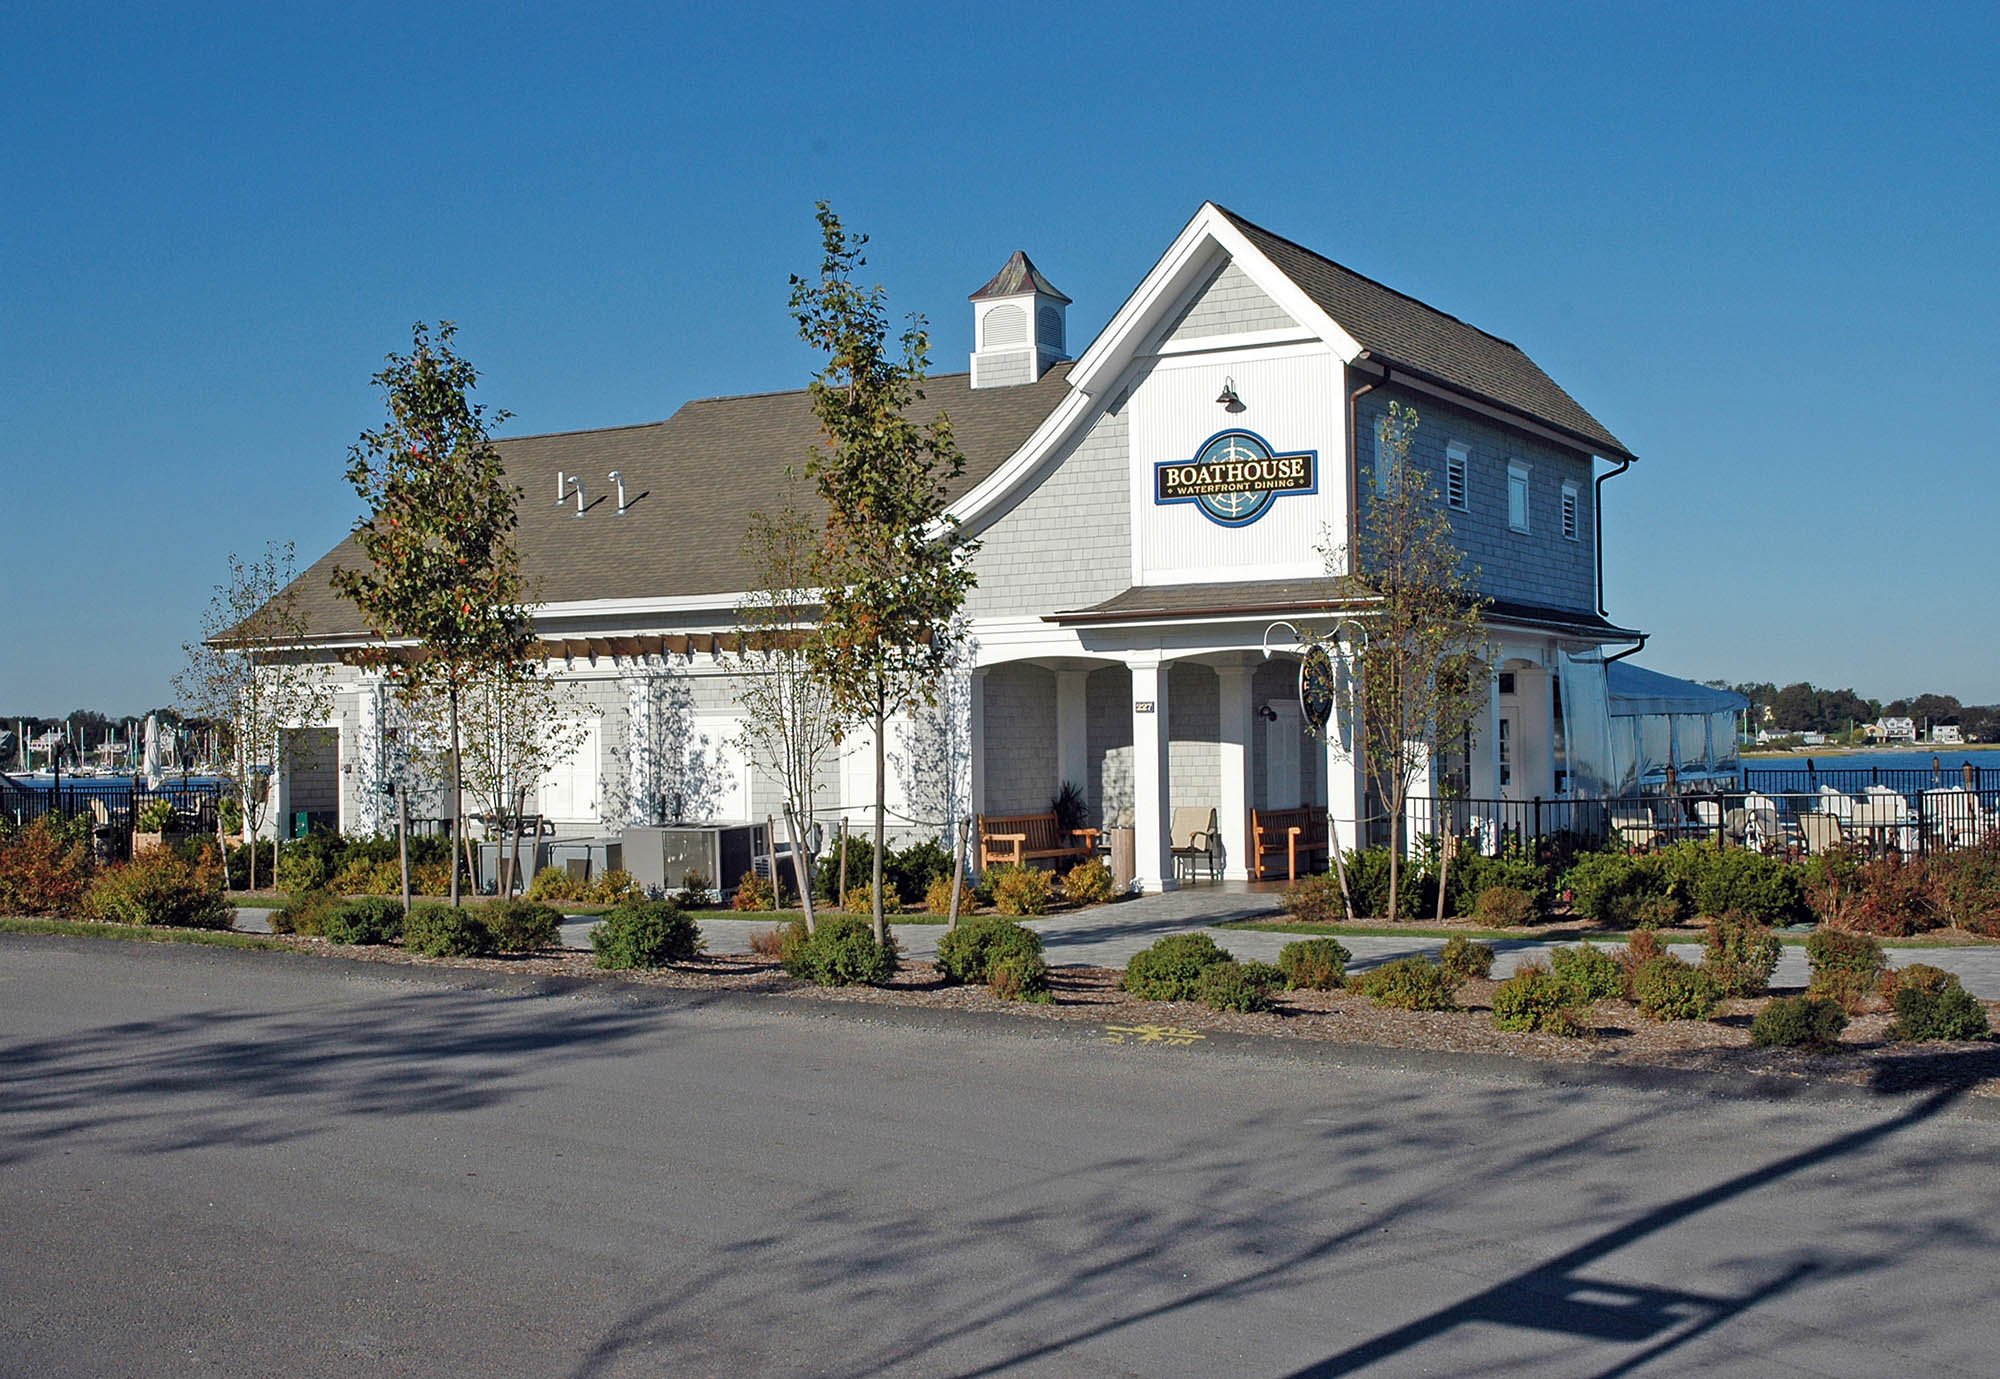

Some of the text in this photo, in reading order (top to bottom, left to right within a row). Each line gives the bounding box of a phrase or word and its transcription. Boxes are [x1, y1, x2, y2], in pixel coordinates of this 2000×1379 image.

[1166, 458, 1304, 486] BOATHOUSE
[1177, 479, 1295, 495] WATERFRONT DINING
